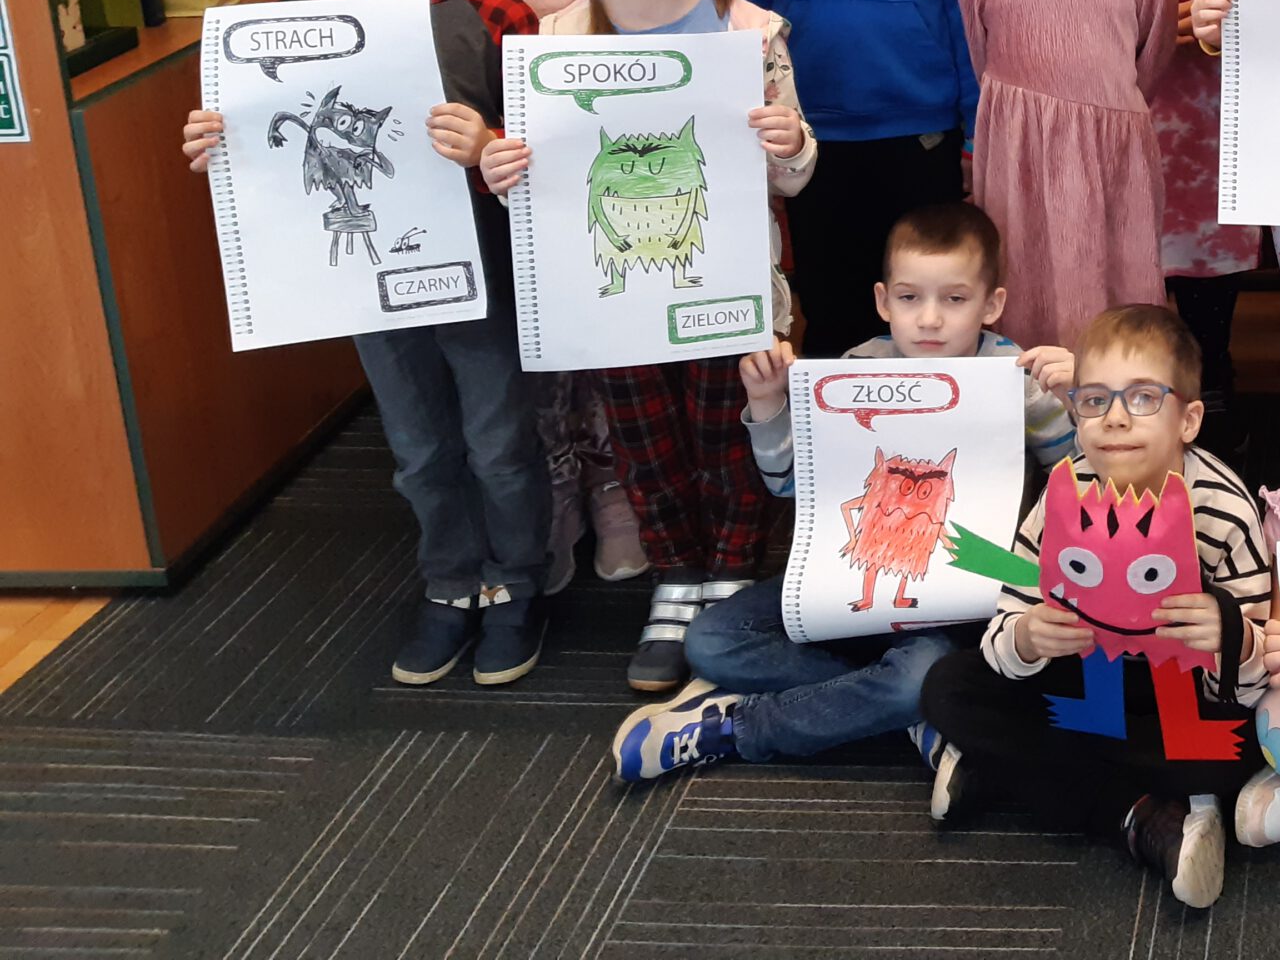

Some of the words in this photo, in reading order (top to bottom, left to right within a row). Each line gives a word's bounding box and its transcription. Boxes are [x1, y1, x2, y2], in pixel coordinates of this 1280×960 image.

[249, 27, 335, 52] STRACH
[563, 59, 658, 84] SPOKÓJ
[393, 275, 462, 297] CZARNY
[681, 308, 750, 329] ZIELONY
[852, 380, 923, 403] ZŁOŚĆ
